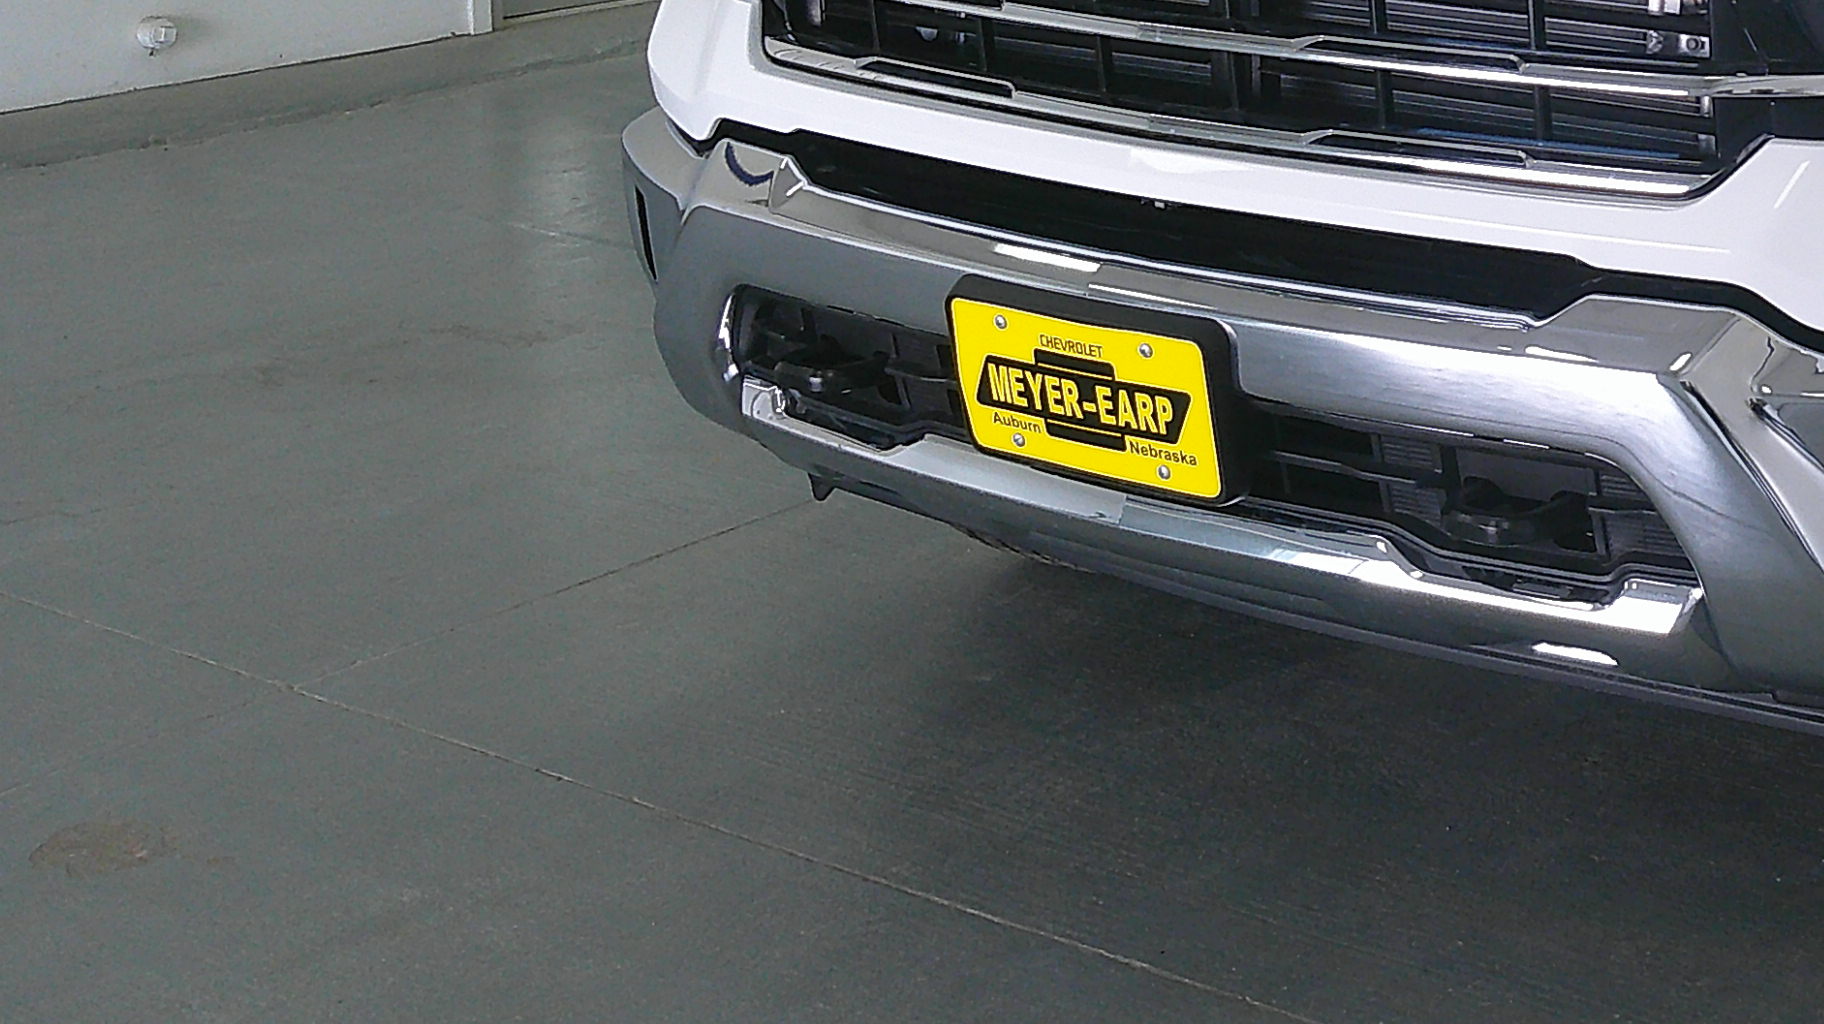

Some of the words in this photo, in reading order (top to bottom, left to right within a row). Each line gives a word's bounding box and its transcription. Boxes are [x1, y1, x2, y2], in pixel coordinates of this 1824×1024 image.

[1040, 334, 1103, 358] CHEVROLET
[987, 362, 1174, 436] MEYER-EARP
[992, 411, 1042, 434] Auburn
[1129, 441, 1198, 466] Nebraska
